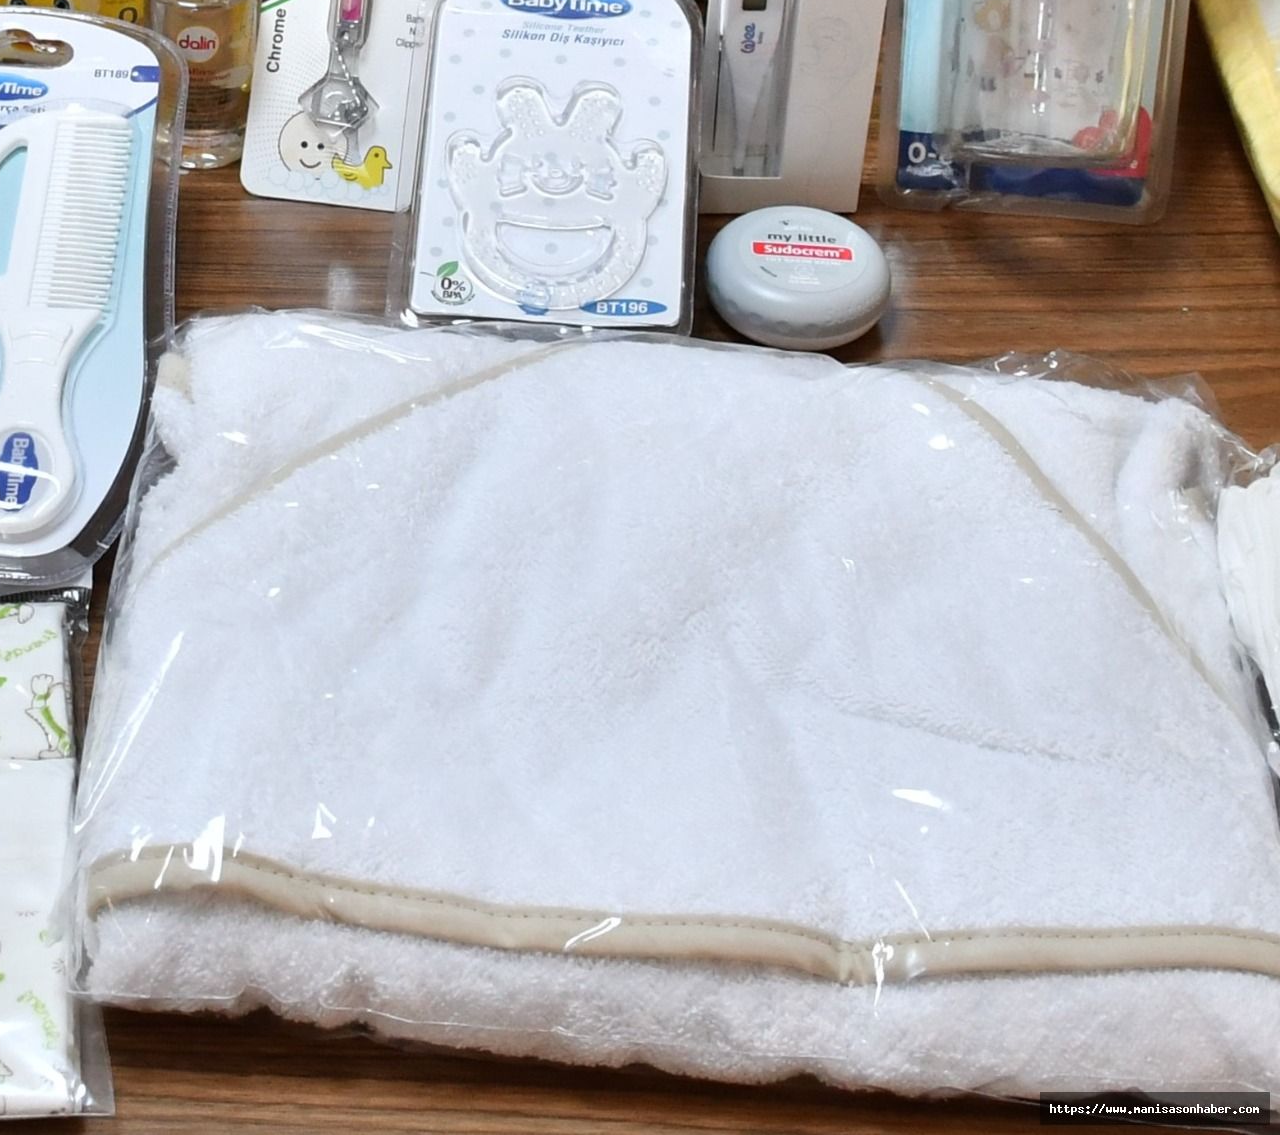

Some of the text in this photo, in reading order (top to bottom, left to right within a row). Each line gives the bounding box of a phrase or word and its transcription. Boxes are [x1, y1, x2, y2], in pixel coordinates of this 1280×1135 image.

[179, 35, 215, 50] dalin
[266, 8, 287, 73] Chrome
[502, 29, 546, 41] Silikon
[550, 32, 570, 44] Diş
[94, 69, 129, 80] BT189
[767, 233, 837, 244] my little
[764, 245, 840, 258] Sudocrem
[441, 277, 466, 291] 0%
[596, 302, 648, 314] BT196
[3, 437, 30, 507] BabTime
